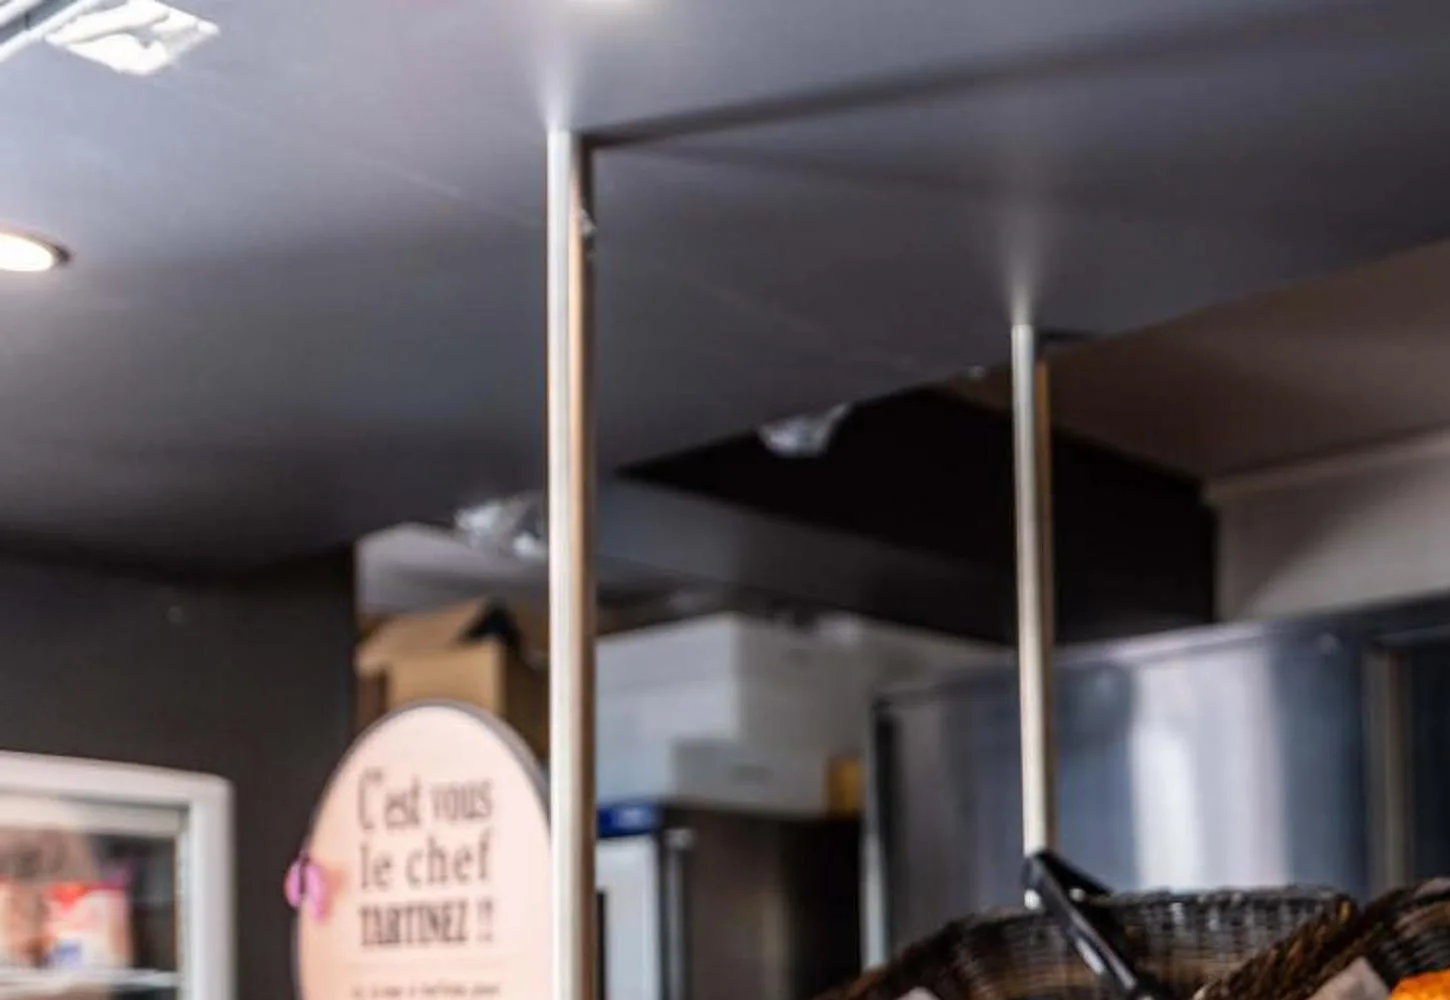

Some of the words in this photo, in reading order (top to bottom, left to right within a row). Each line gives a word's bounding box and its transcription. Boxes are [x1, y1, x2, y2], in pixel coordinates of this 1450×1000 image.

[431, 777, 494, 824] vous
[359, 843, 393, 888] le
[405, 826, 493, 888] chef
